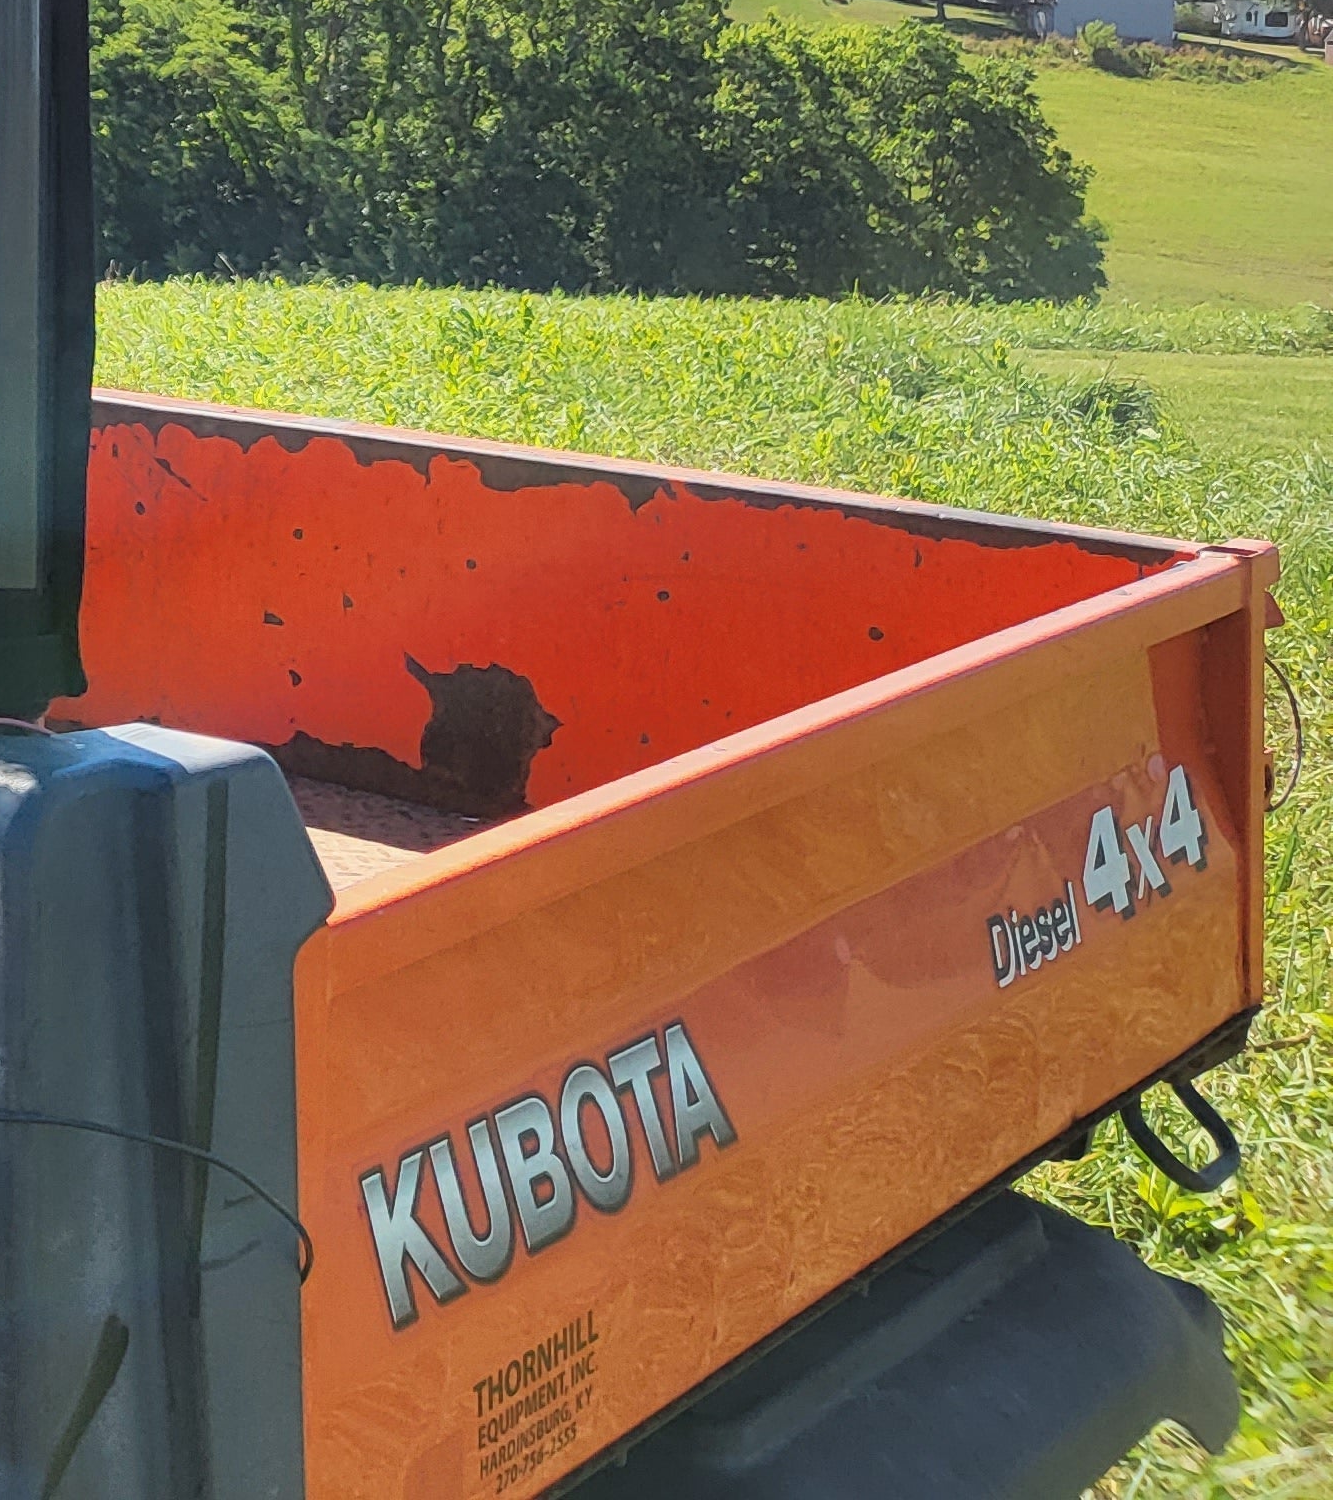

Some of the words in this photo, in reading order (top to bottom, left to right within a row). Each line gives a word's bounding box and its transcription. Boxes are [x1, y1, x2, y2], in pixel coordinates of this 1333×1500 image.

[986, 878, 1082, 989] Diesel
[1083, 764, 1209, 920] 4x4
[358, 1018, 739, 1331] KUBOTA
[472, 1309, 599, 1418] THORNHILL
[575, 1384, 593, 1413] KY
